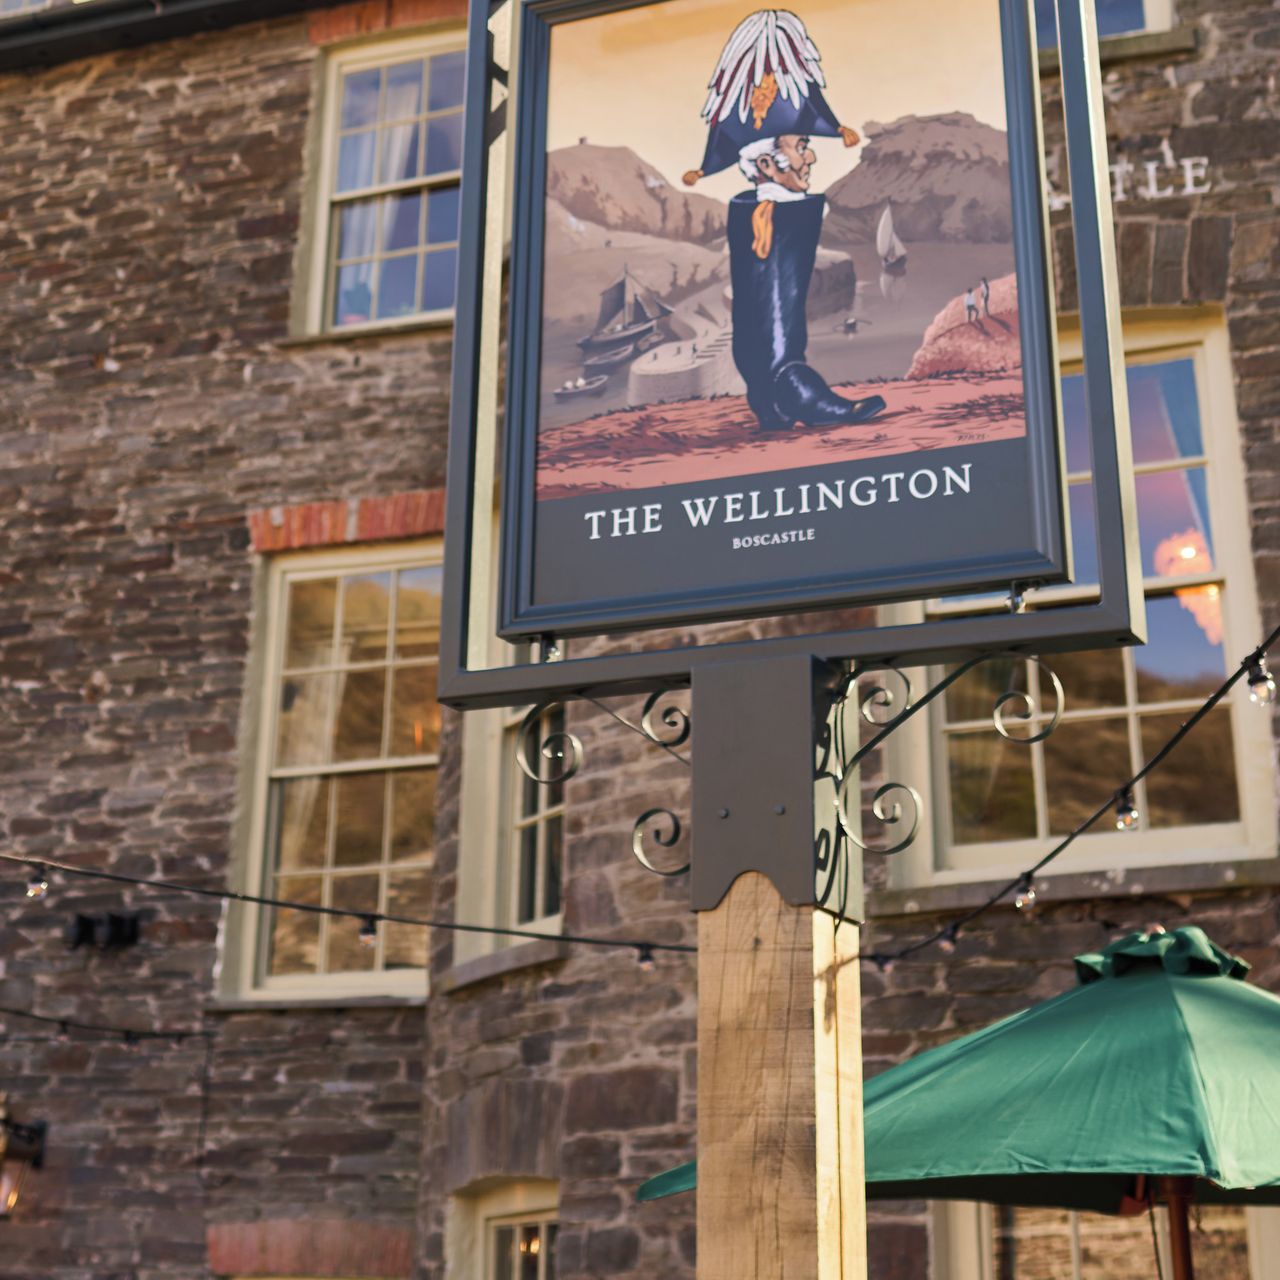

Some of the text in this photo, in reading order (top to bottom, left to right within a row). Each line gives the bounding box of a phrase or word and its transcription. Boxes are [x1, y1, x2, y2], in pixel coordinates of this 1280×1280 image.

[583, 463, 973, 540] THE WELLINGTON
[732, 527, 816, 550] BOSCASTLE
